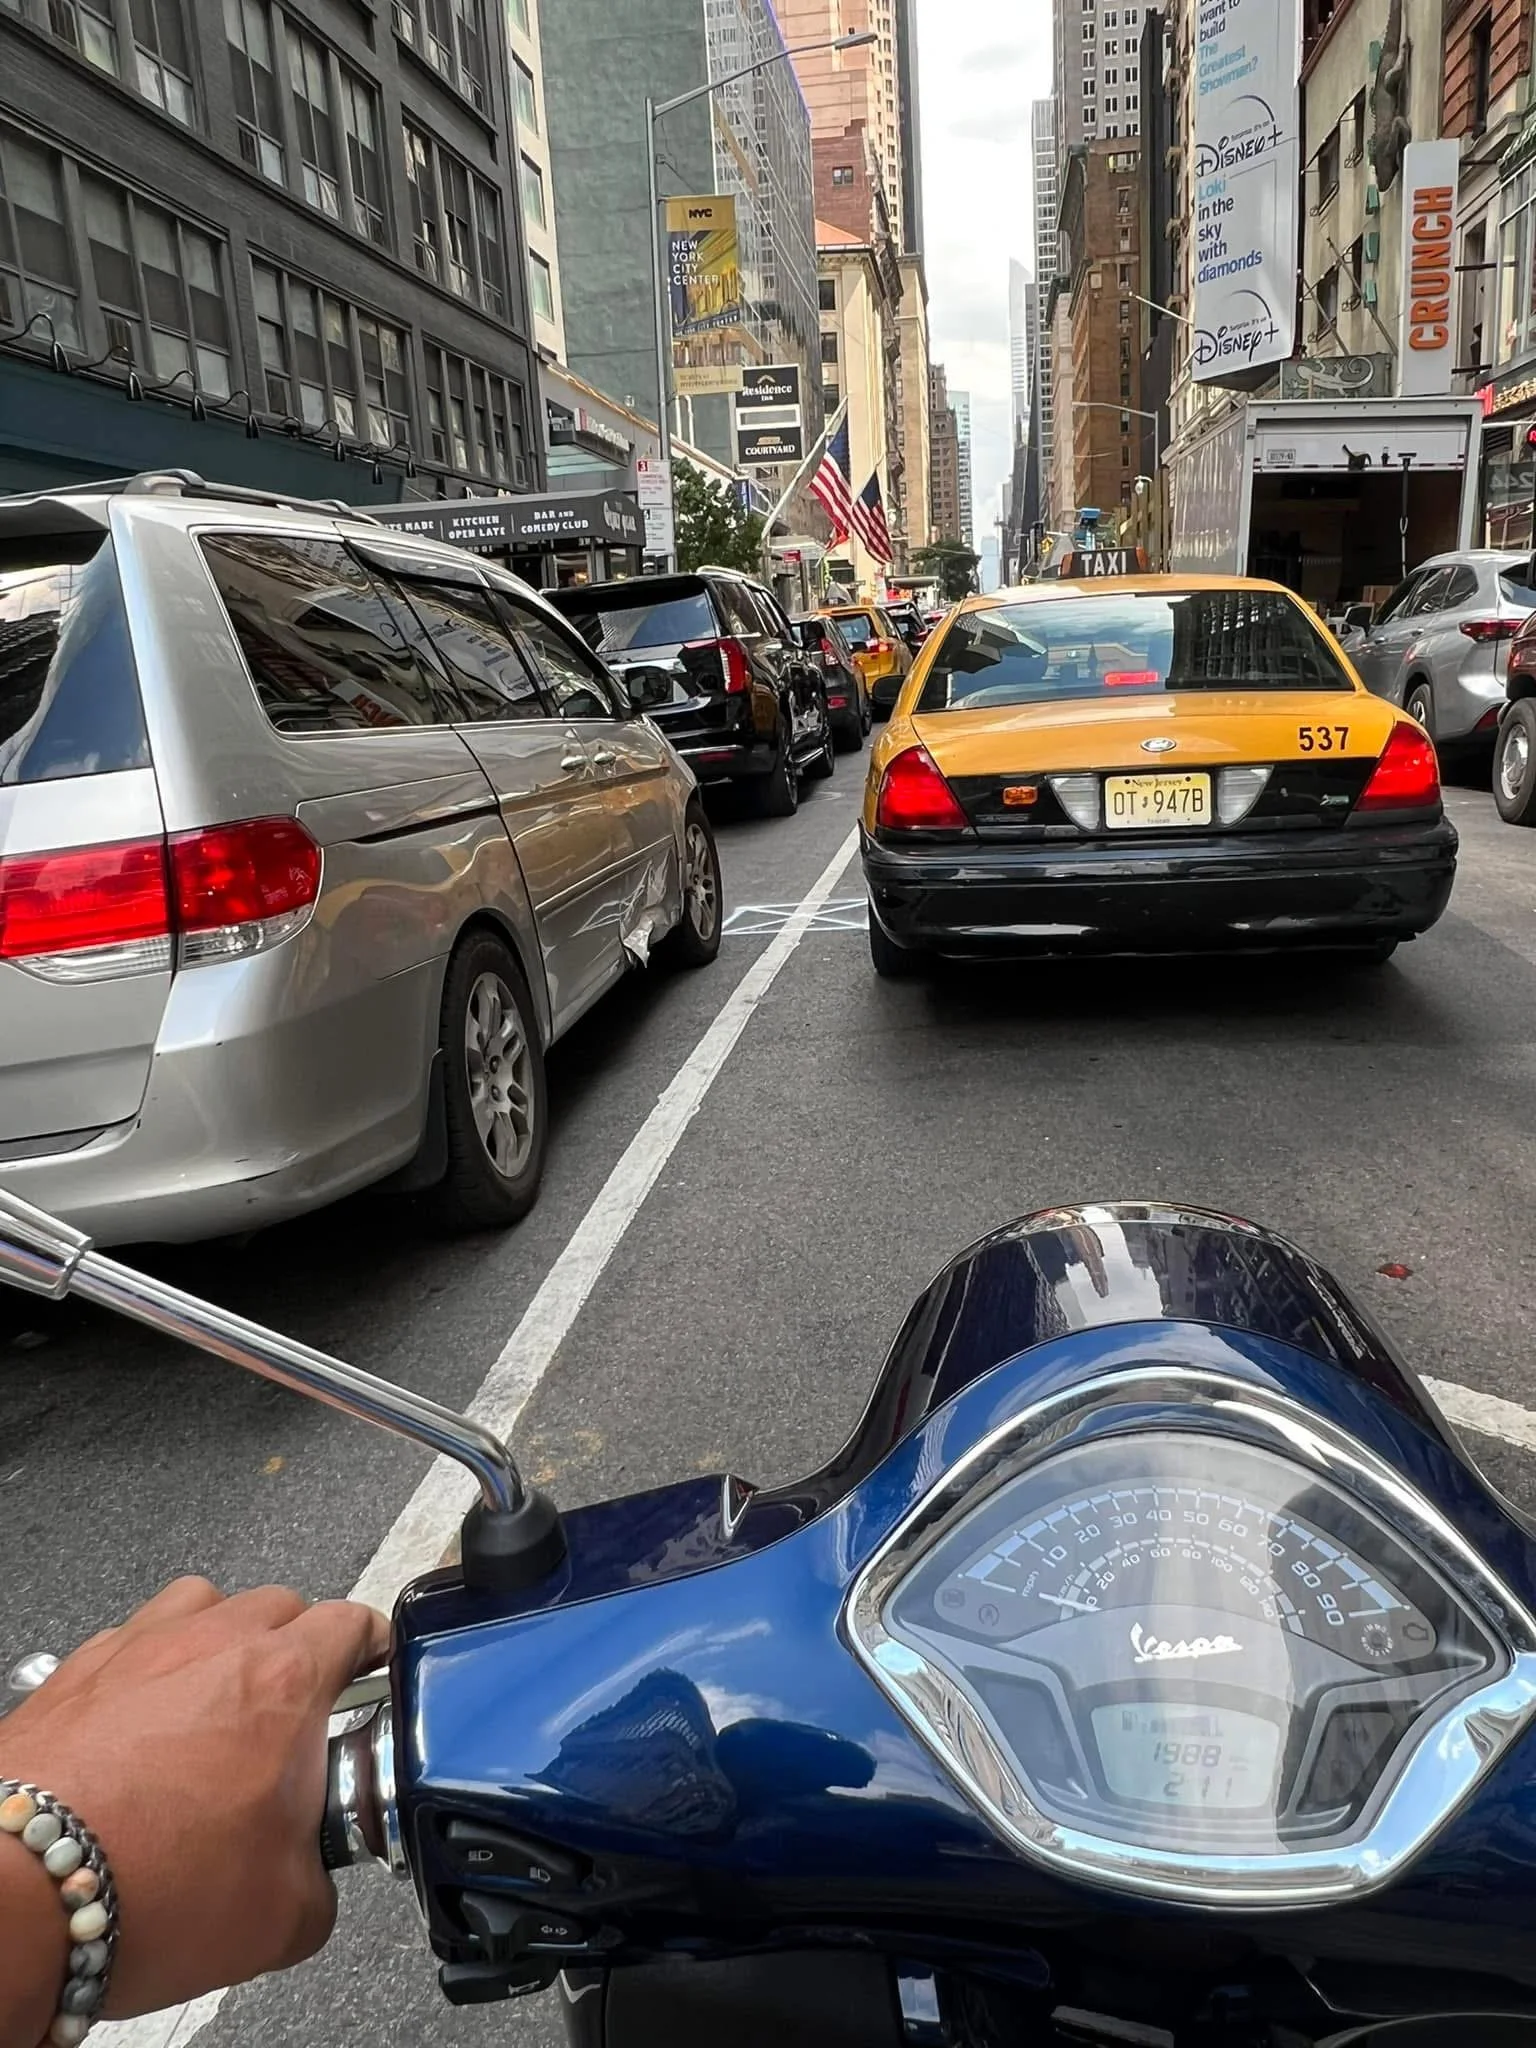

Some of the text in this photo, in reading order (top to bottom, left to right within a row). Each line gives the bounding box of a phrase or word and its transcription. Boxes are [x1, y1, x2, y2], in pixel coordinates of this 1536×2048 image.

[1200, 1, 1226, 24] want
[1200, 17, 1226, 42] build
[1199, 44, 1246, 77] Greatest
[1199, 55, 1258, 96] Showman?
[1198, 174, 1226, 201] Loki
[688, 208, 713, 218] NYC
[1198, 197, 1234, 221] in the
[1198, 223, 1222, 242] sky
[672, 240, 698, 251] NEW
[672, 252, 705, 262] YORK
[1198, 240, 1227, 263] with
[673, 263, 698, 274] CITY
[1198, 250, 1263, 284] diamonds
[1409, 186, 1453, 350] CRUNCH
[673, 274, 719, 286] CENTER
[742, 384, 793, 396] Residence
[745, 444, 796, 456] COURTYARD
[405, 520, 434, 531] MADE
[453, 515, 500, 527] KITCHEN
[521, 519, 589, 534] COMEDY CLUB
[534, 510, 574, 520] BAR AND
[448, 526, 506, 540] OPEN LATE
[1081, 551, 1127, 576] TAXI
[1299, 726, 1349, 752] 537
[1153, 788, 1204, 814] 947B
[1042, 1510, 1345, 1626] 10 20 30 40 50 60 70 80 90
[1086, 1595, 1097, 1607] 0
[1096, 1570, 1115, 1591] 20
[1121, 1553, 1140, 1568] 40
[1150, 1547, 1171, 1558] 60
[1211, 1556, 1233, 1573] 100
[1130, 1622, 1243, 1664] Vespa
[1153, 1741, 1222, 1768] 1988
